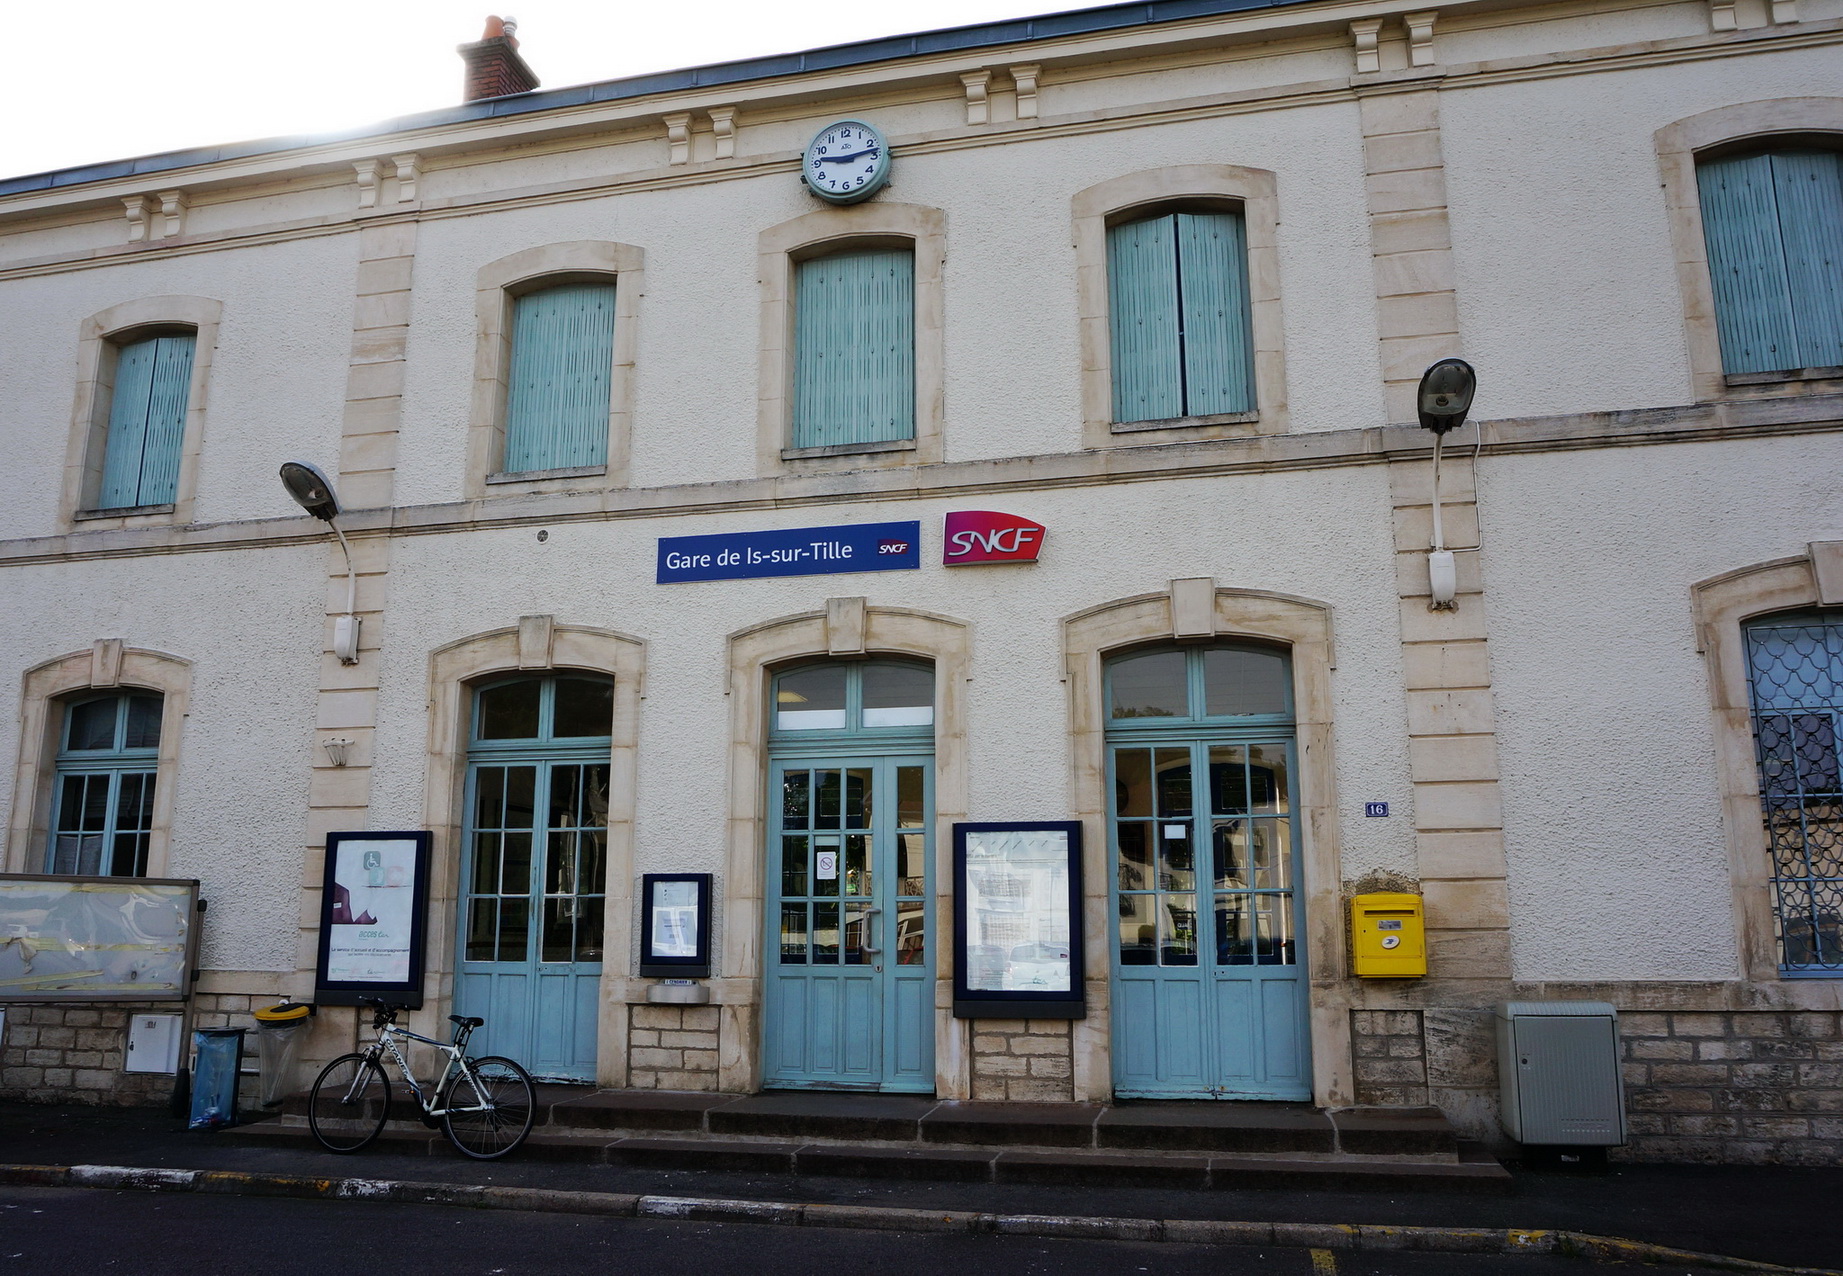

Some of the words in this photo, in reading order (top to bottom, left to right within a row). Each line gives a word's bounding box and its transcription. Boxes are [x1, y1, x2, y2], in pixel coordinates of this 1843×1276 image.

[841, 129, 851, 138] 12
[858, 131, 861, 139] 1
[828, 135, 835, 144] 11
[866, 139, 874, 148] 2
[816, 146, 827, 155] 10
[870, 151, 878, 160] 3
[814, 160, 822, 168] 9
[865, 165, 874, 174] 4
[818, 171, 826, 180] 8
[829, 180, 836, 189] 7
[856, 176, 864, 185] 5
[842, 181, 850, 190] 6
[947, 528, 1039, 556] SNCF
[878, 543, 908, 554] SNCF
[666, 552, 711, 569] Gare
[717, 549, 741, 566] de
[747, 541, 853, 564] Is-sur-Tille
[1370, 804, 1384, 815] 16
[386, 1038, 407, 1071] GITANE
